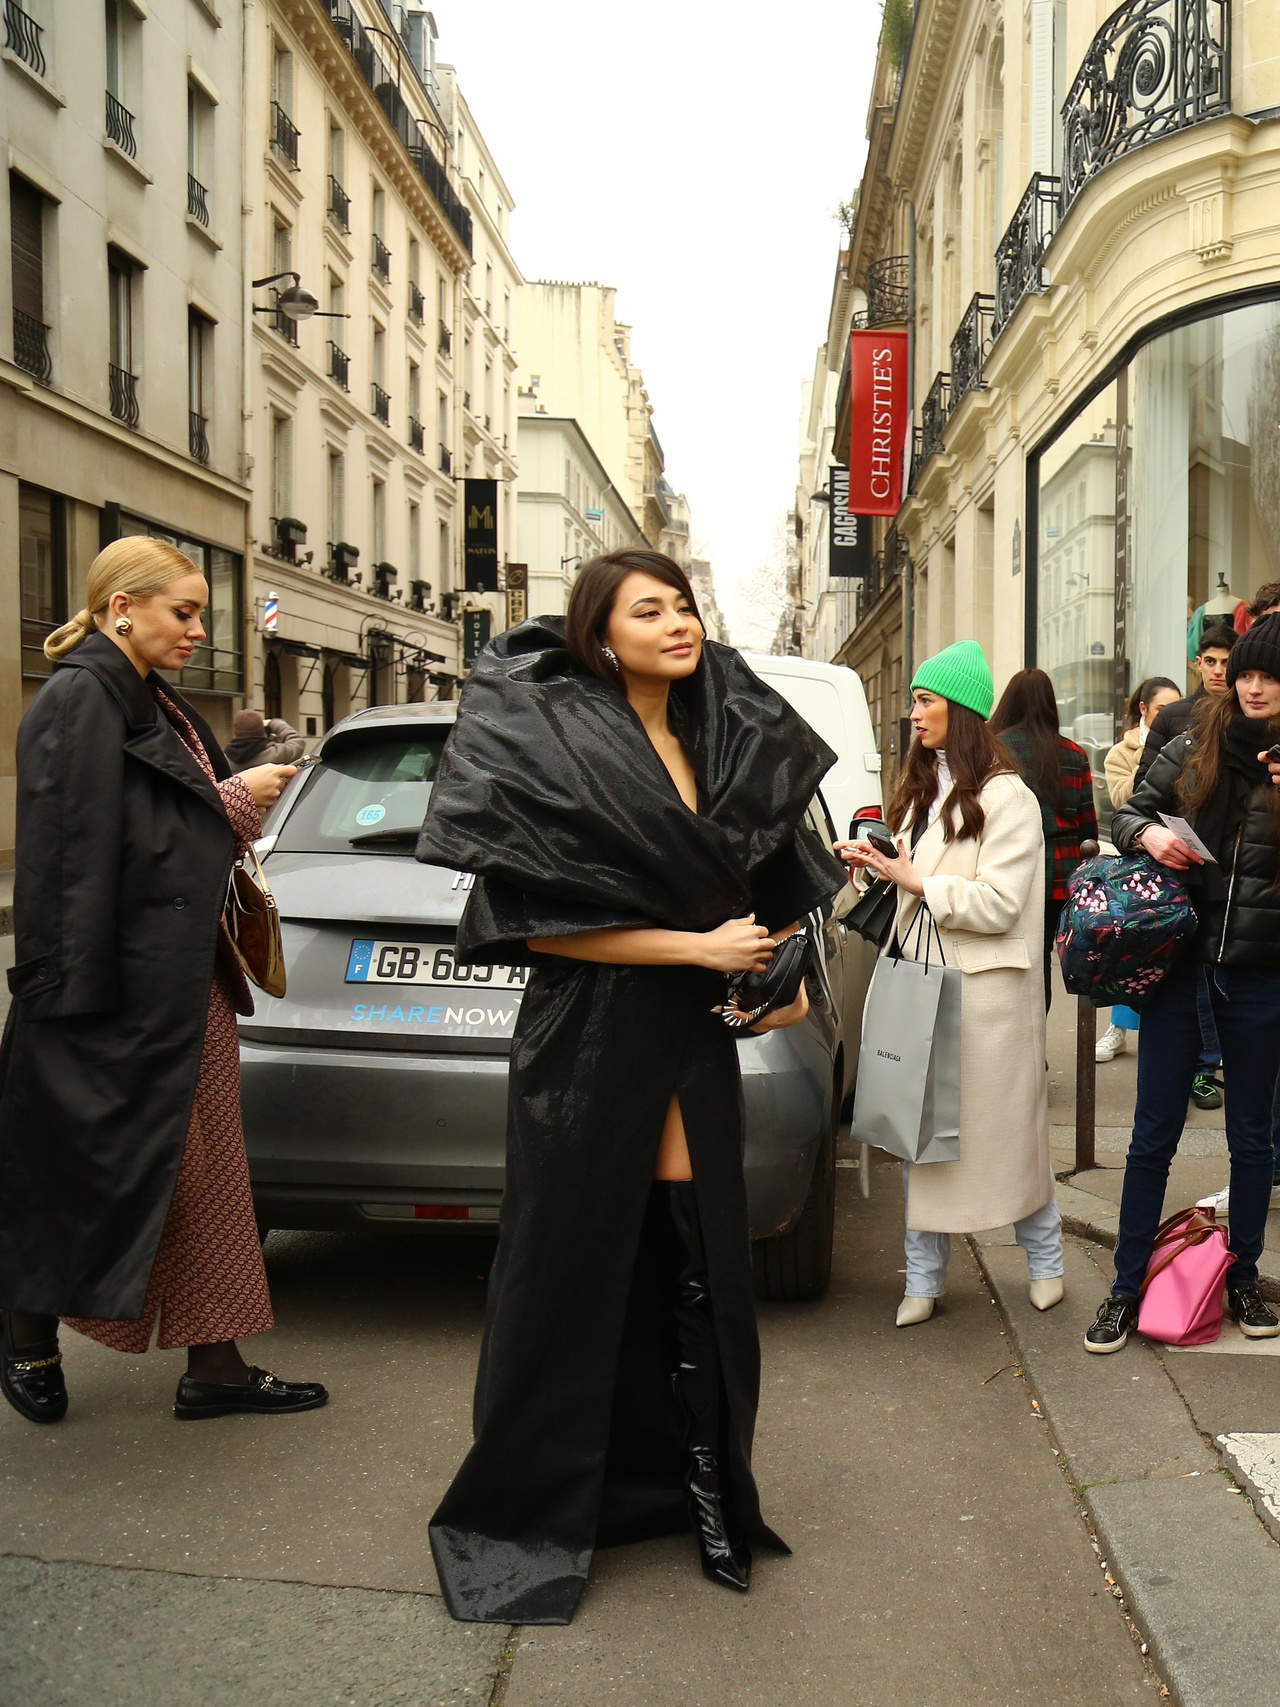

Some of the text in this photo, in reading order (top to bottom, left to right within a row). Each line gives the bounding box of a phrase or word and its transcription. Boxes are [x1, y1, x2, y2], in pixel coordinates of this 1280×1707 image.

[870, 348, 893, 498] CHRISTIE'S
[834, 470, 857, 547] GAGOSIAN
[1115, 424, 1127, 743] HRISTIE'S
[361, 810, 381, 821] 165
[354, 964, 363, 974] F
[351, 1003, 514, 1027] SHARENOW
[877, 1049, 901, 1063] BALENCIAGA
